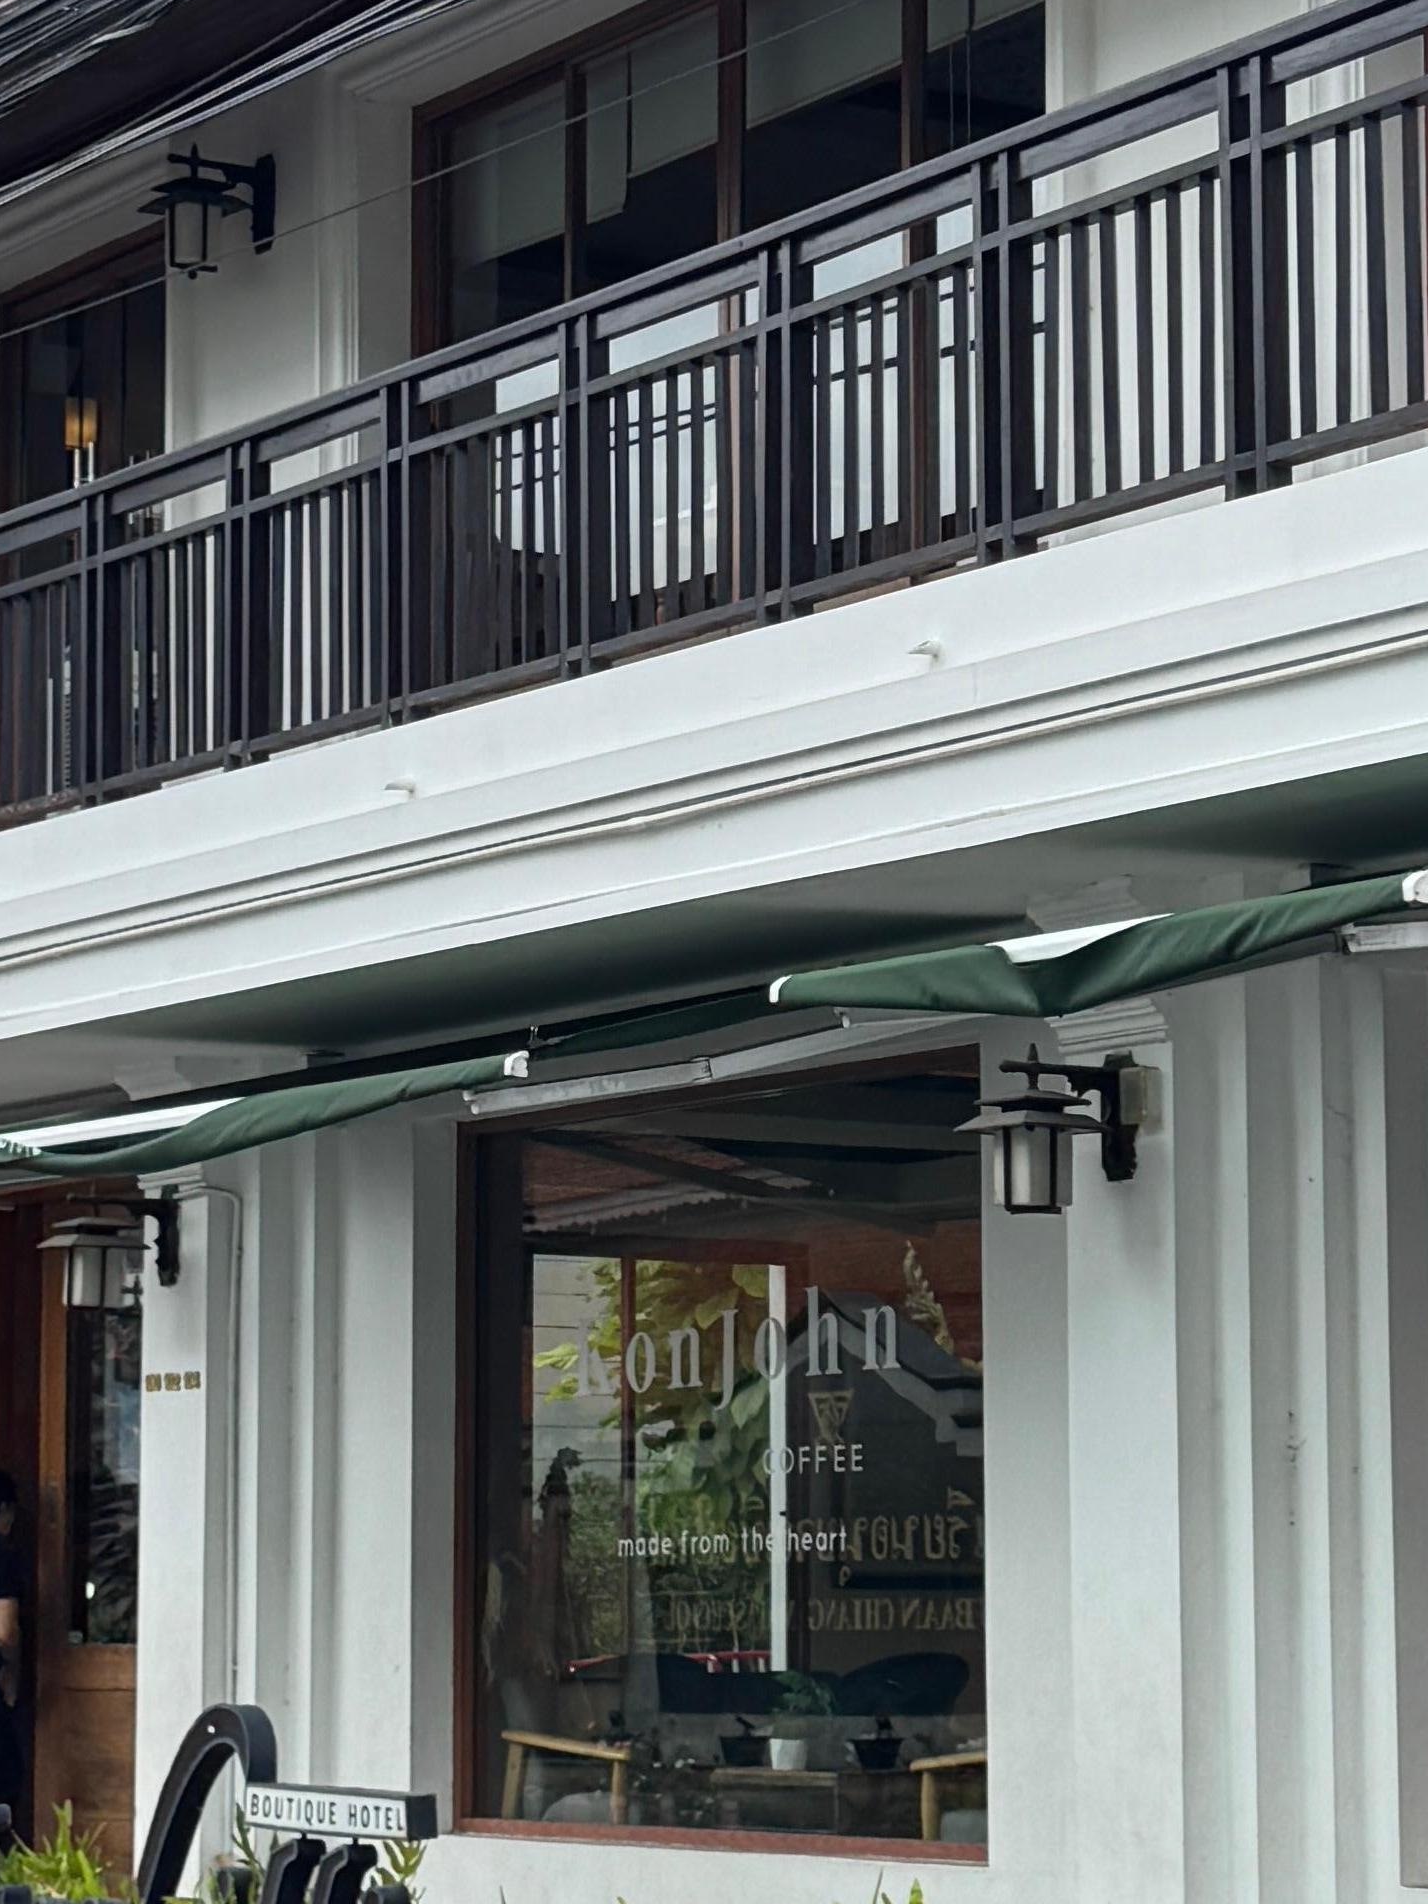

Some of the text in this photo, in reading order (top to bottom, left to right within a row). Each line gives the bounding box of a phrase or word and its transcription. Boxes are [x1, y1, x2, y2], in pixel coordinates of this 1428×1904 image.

[762, 1444, 864, 1476] COFFEE
[617, 1524, 848, 1558] made from the heart
[250, 1793, 404, 1832] BOUTIQUE HOTEL
